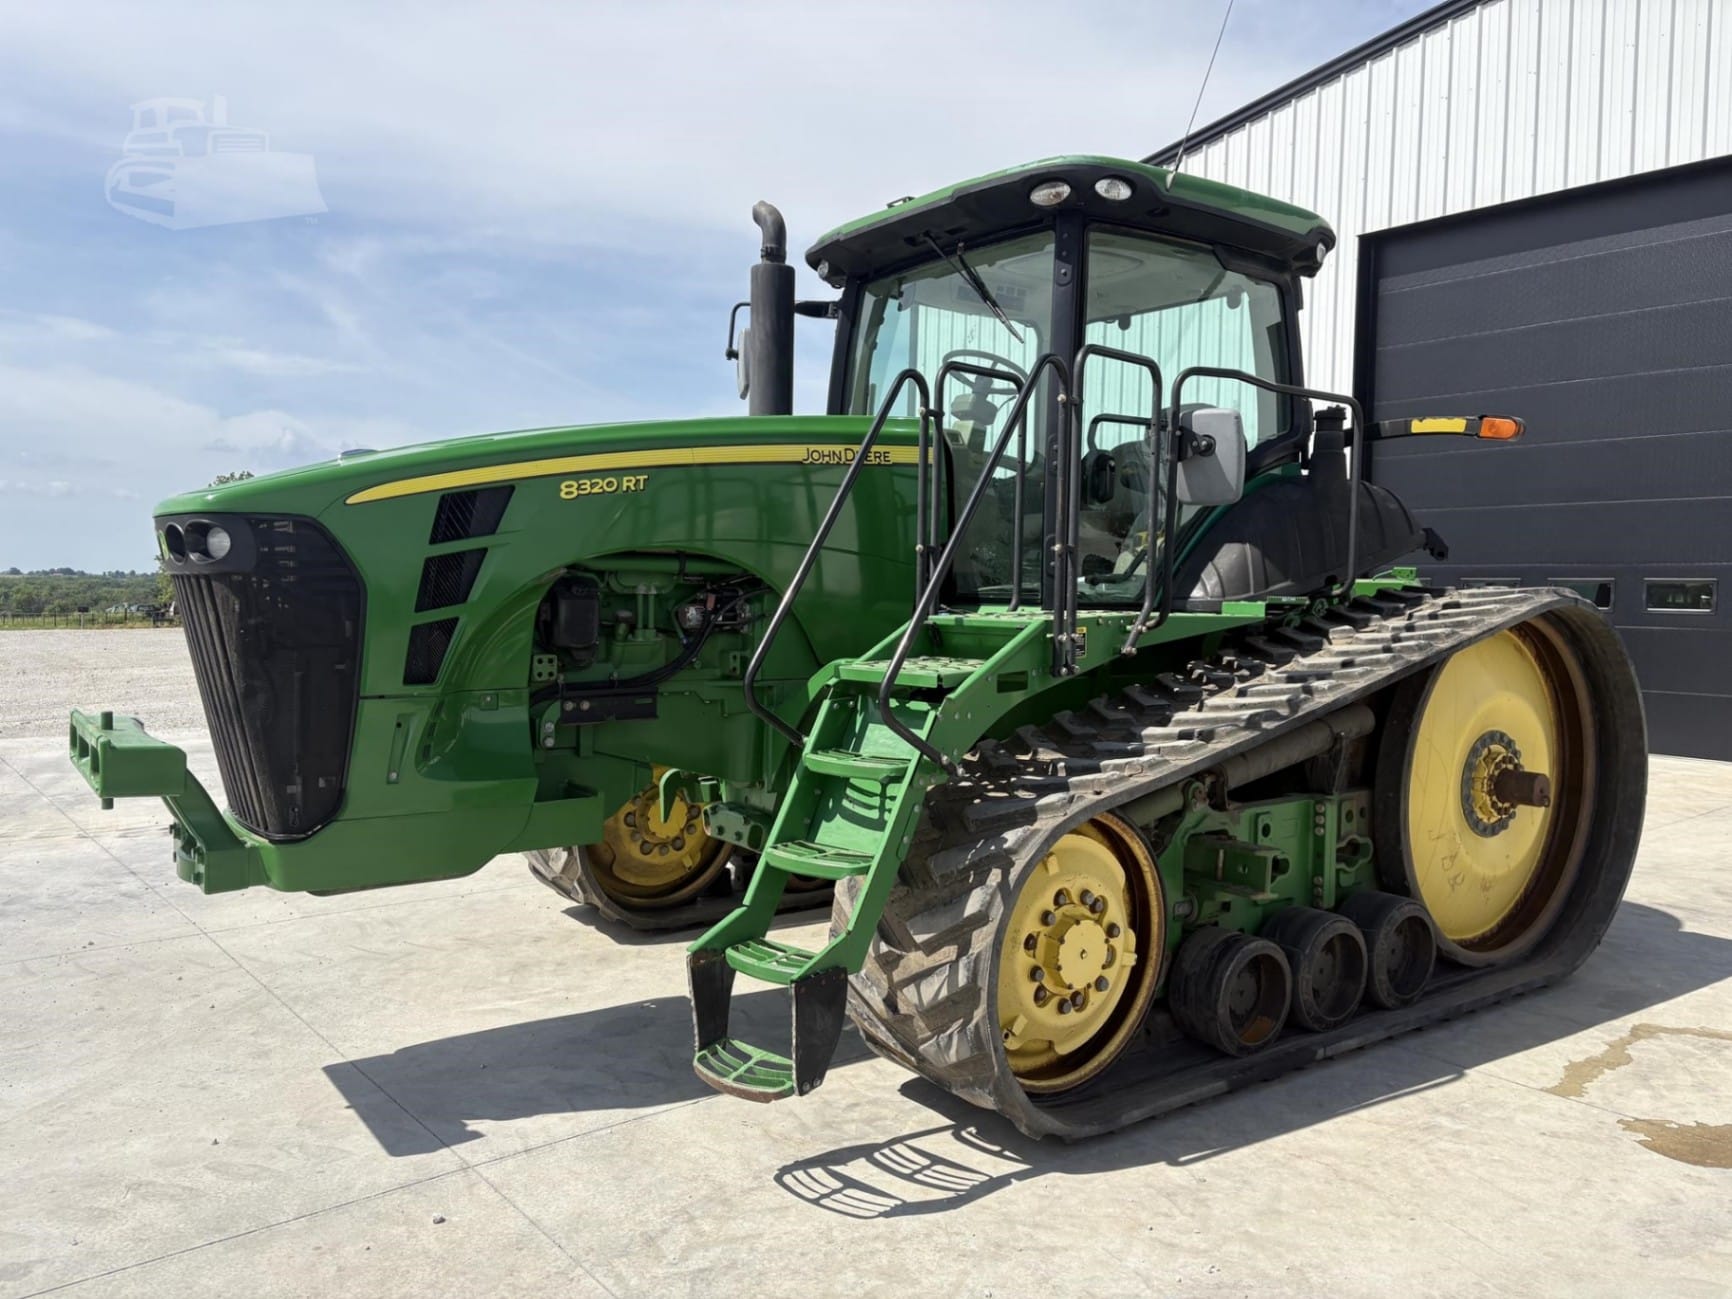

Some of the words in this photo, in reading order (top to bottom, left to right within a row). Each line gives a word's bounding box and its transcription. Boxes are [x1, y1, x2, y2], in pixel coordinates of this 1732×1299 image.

[802, 447, 842, 463] JOHN
[844, 447, 891, 463] DERE
[560, 477, 618, 499] 8320
[622, 474, 649, 492] RT
